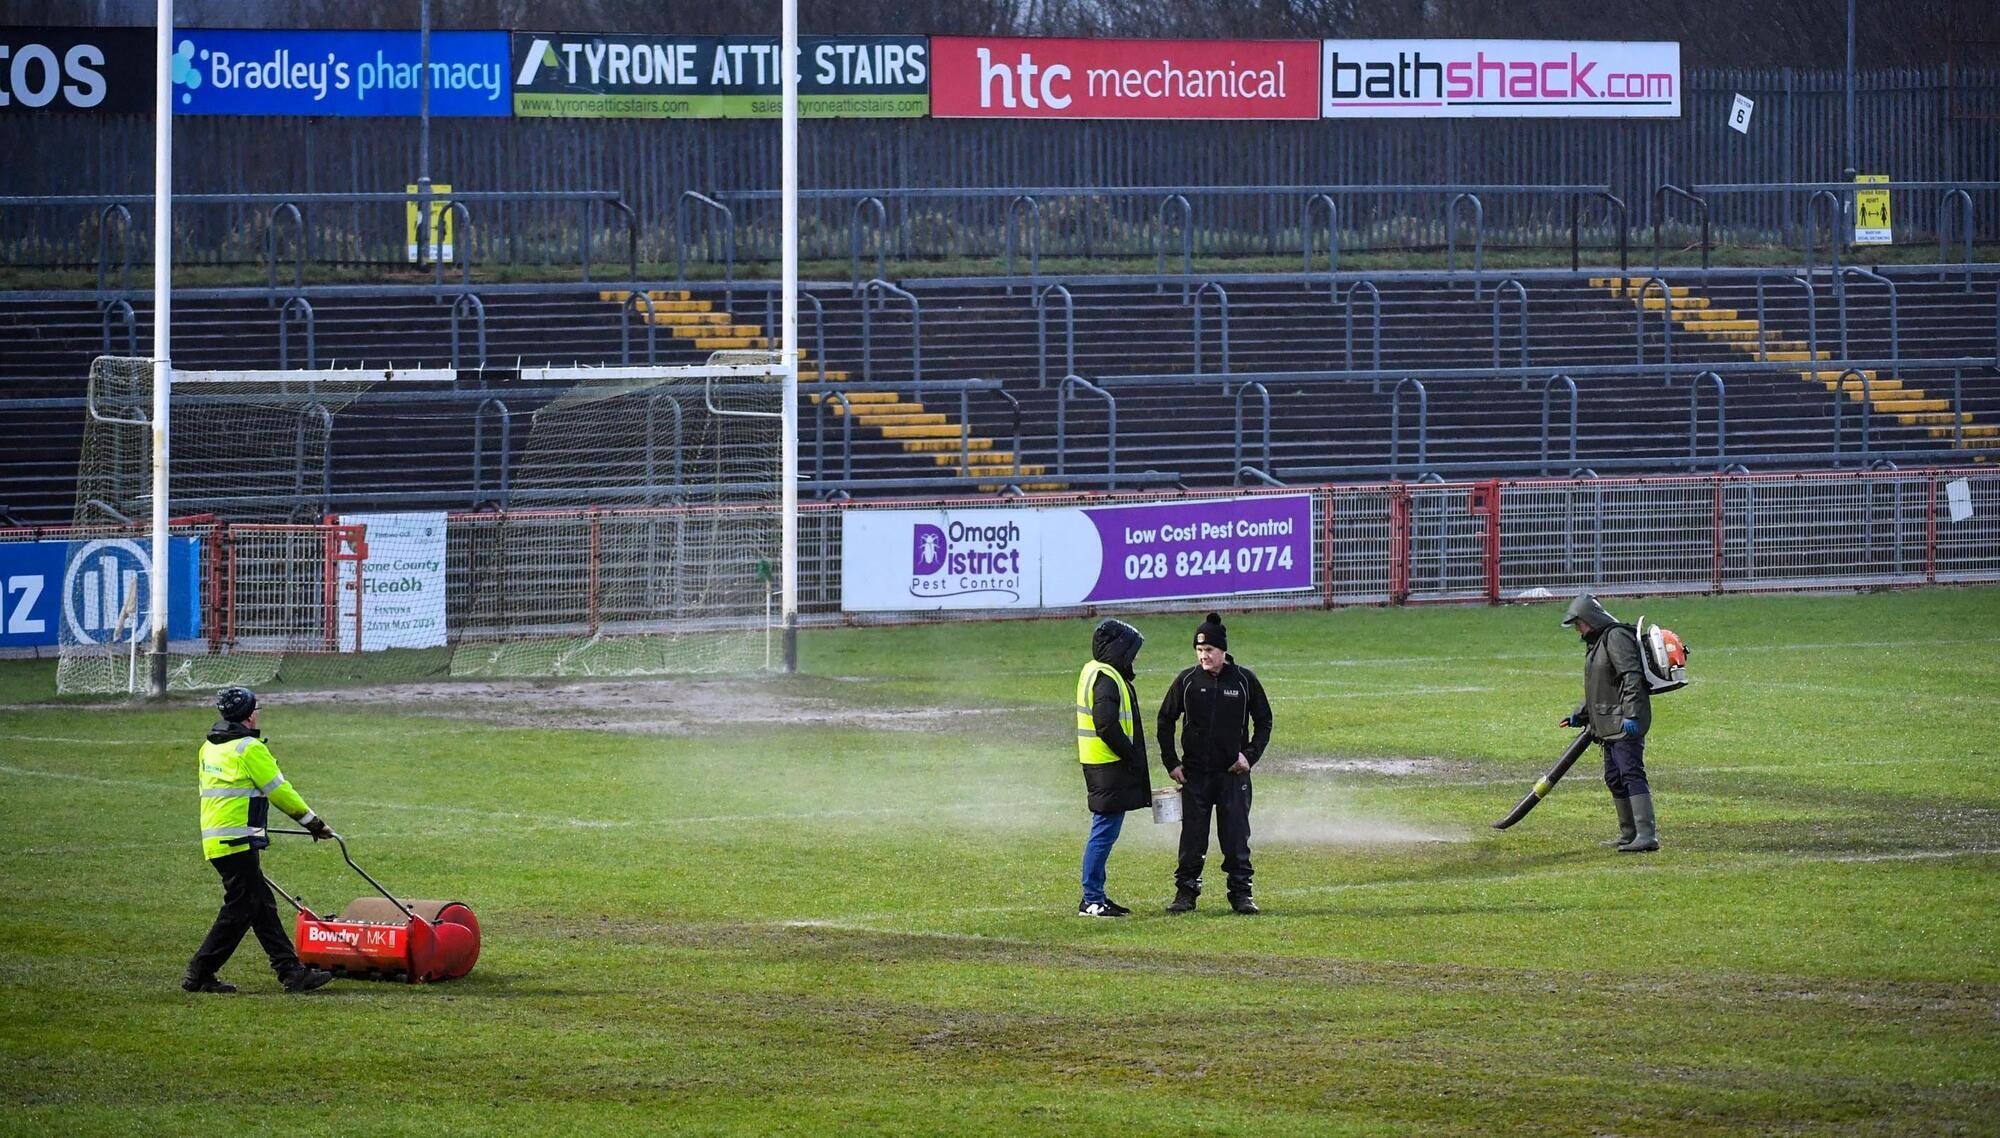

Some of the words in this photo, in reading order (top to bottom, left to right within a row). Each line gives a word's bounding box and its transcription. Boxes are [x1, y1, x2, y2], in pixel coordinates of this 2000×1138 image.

[211, 49, 350, 101] Bradley's
[357, 49, 501, 101] pharmacy
[561, 43, 698, 85] TYRONE
[815, 45, 926, 86] STAIRS
[977, 47, 1072, 109] htc
[1086, 60, 1286, 98] mechanical
[1332, 52, 1672, 98] bathshack.com
[521, 98, 690, 114] www.tyroneatticstairs.com
[1736, 109, 1745, 124] 6
[949, 521, 1020, 549] Omagh
[1125, 527, 1156, 544] Low
[1160, 523, 1197, 542] Cost
[1201, 521, 1233, 540] Pest
[1236, 517, 1293, 537] Control
[913, 524, 1020, 575] District
[1125, 553, 1168, 580] 028
[1175, 549, 1231, 577] 8244
[1237, 545, 1293, 573] 0774
[393, 559, 440, 572] County
[363, 577, 423, 594] Fleadh
[912, 578, 946, 589] Pest
[960, 576, 1019, 589] Control
[0, 575, 45, 633] z
[309, 926, 360, 946] Bowdry
[367, 930, 386, 945] MK
